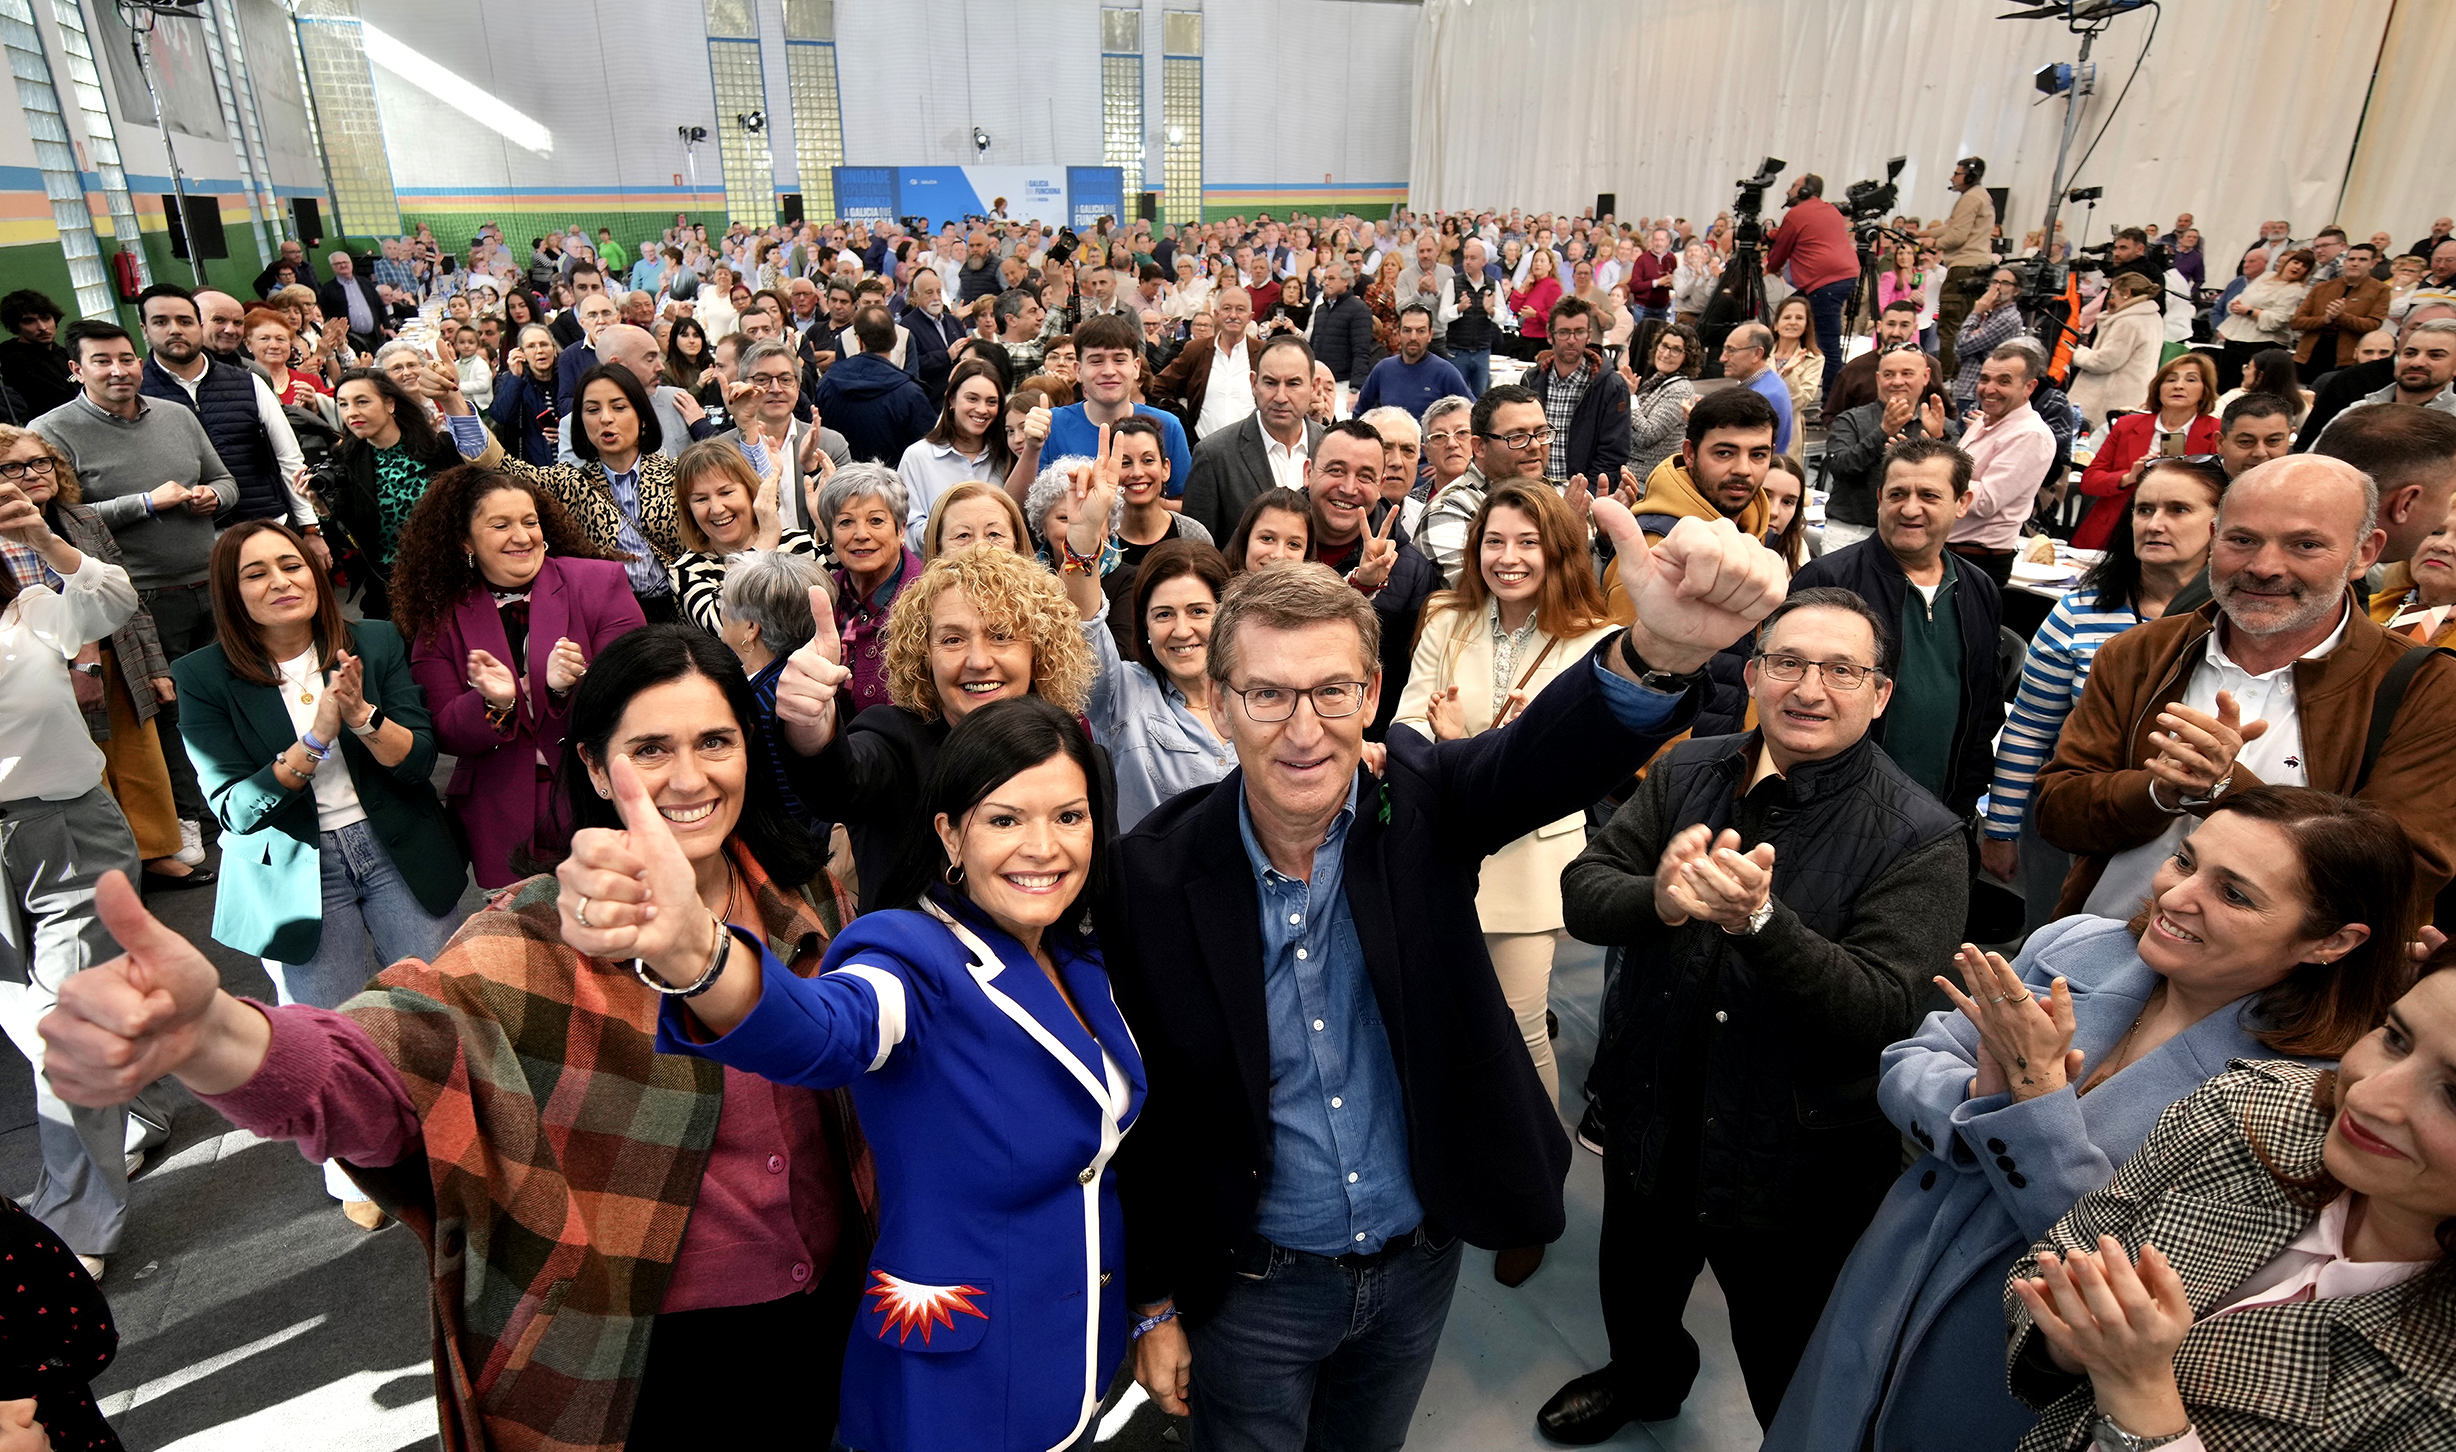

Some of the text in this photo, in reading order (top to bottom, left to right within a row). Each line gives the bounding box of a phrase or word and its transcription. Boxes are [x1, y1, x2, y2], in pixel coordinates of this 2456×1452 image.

[840, 169, 891, 184] UNIDADE
[1035, 187, 1061, 195] FUNCIONA
[843, 206, 892, 217] A GALICIA QUE
[1074, 204, 1117, 214] A GALICIA QUE
